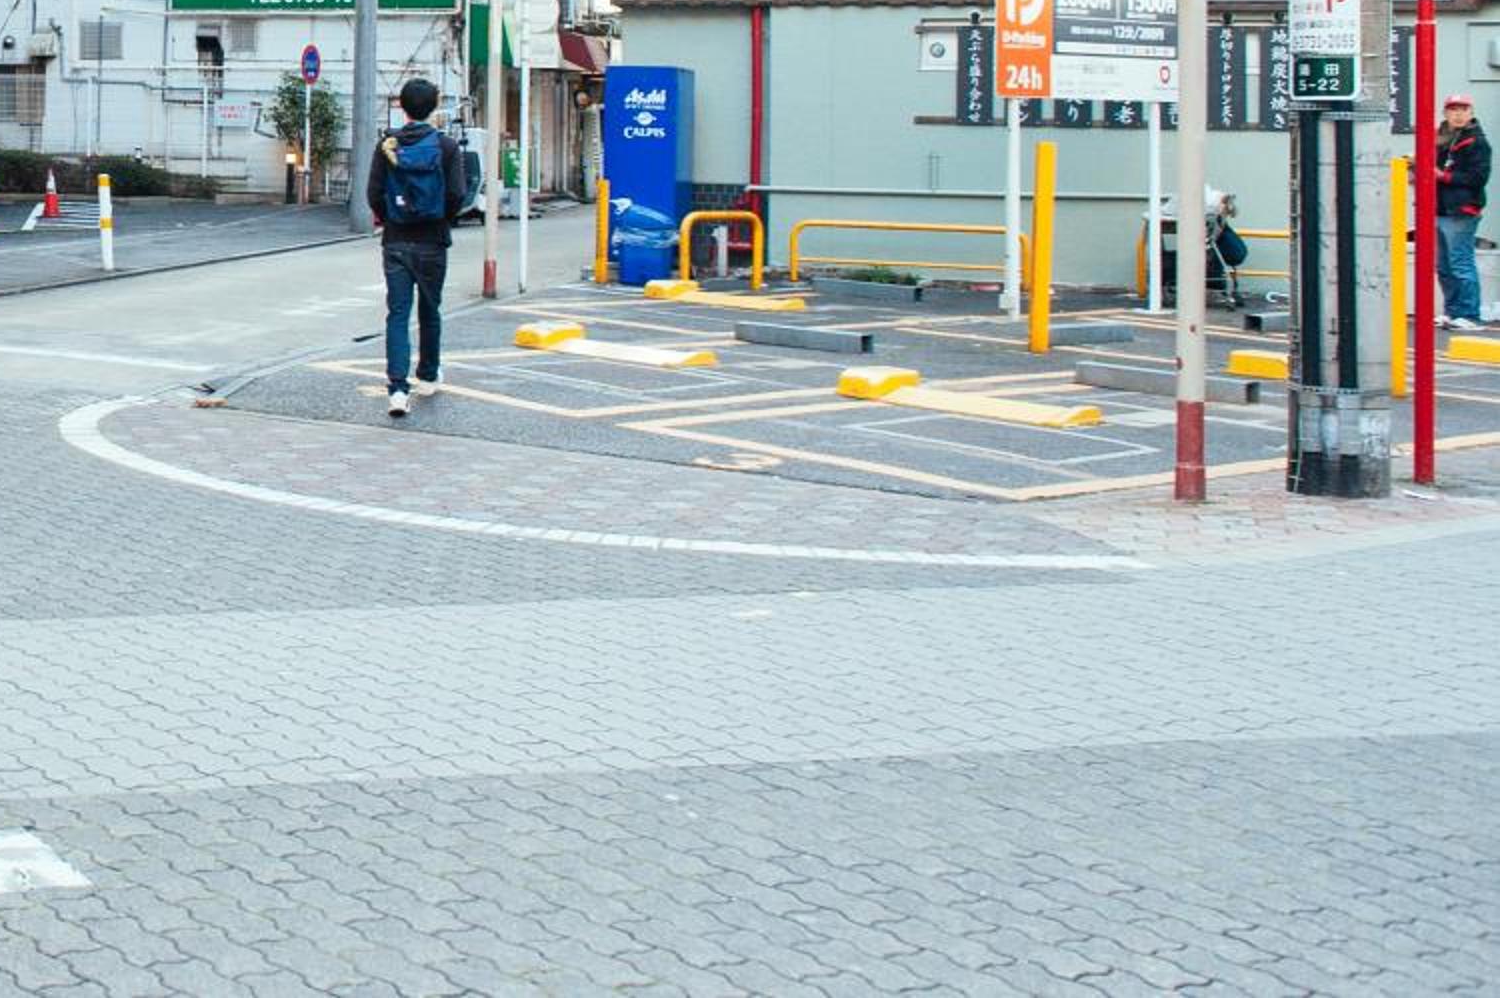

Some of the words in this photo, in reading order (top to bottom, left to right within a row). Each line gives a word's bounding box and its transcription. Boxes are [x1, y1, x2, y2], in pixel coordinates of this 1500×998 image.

[1006, 64, 1043, 91] 24h
[1298, 78, 1340, 91] 5-22
[623, 125, 666, 139] CALPIS
